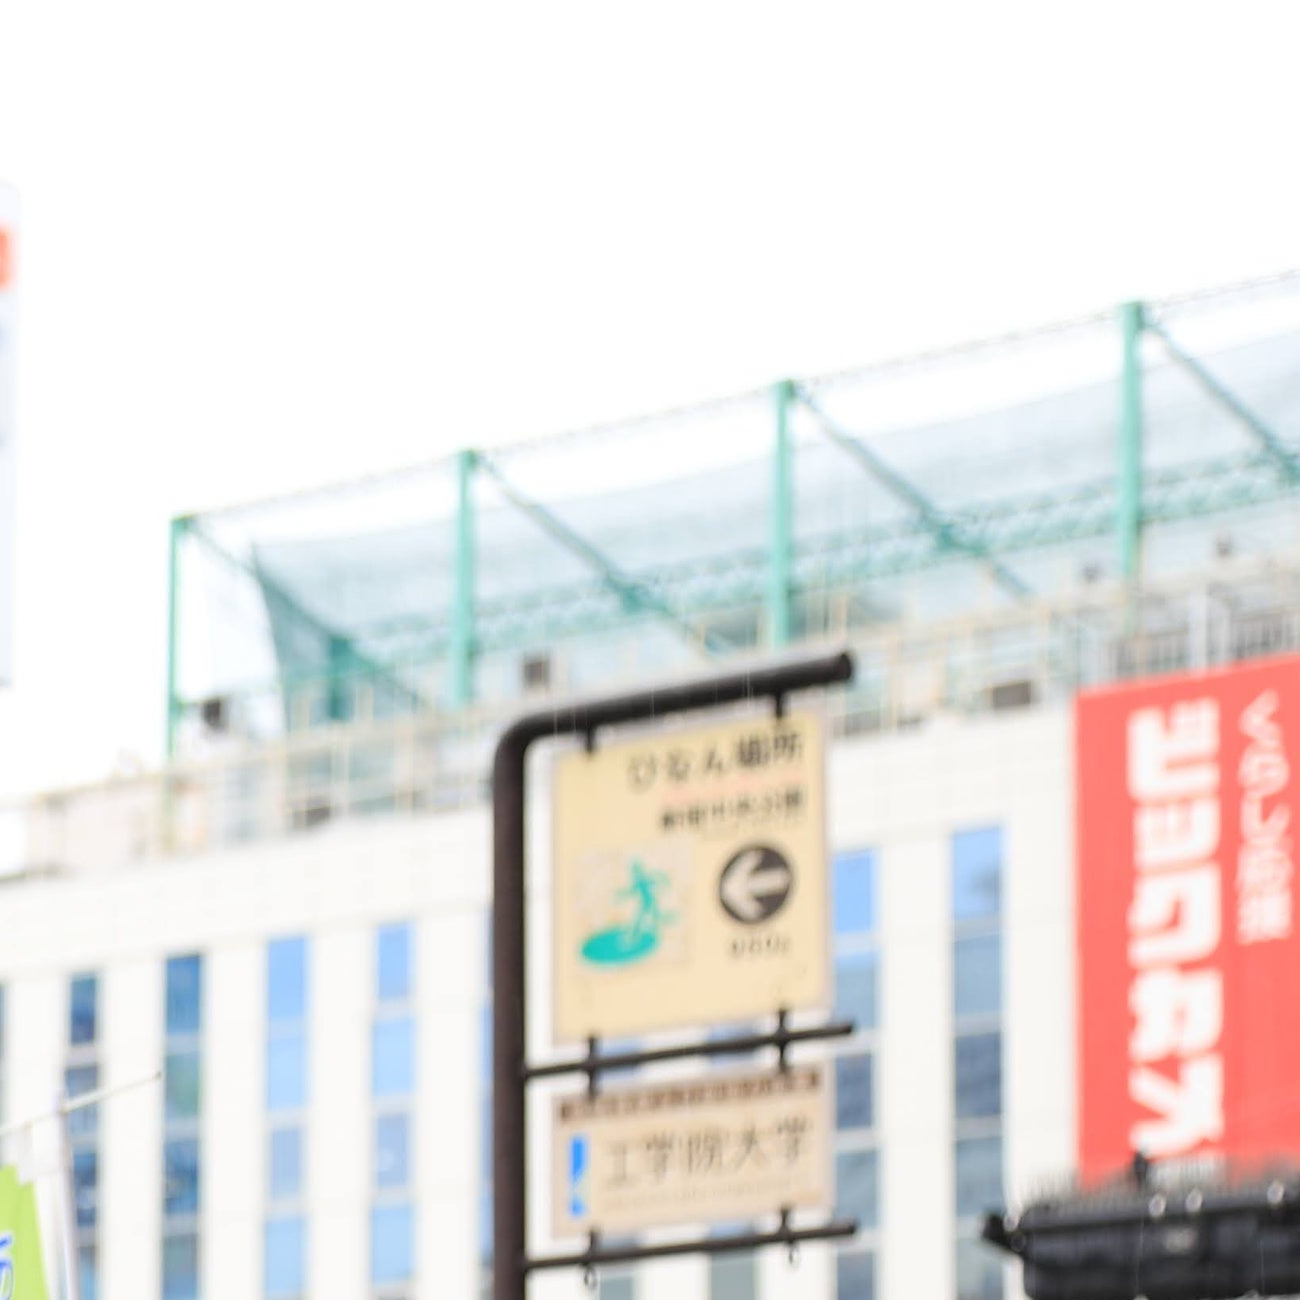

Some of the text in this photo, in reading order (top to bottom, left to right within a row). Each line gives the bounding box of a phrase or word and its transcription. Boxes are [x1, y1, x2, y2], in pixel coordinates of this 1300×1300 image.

[1127, 699, 1224, 1172] ビックカメ
